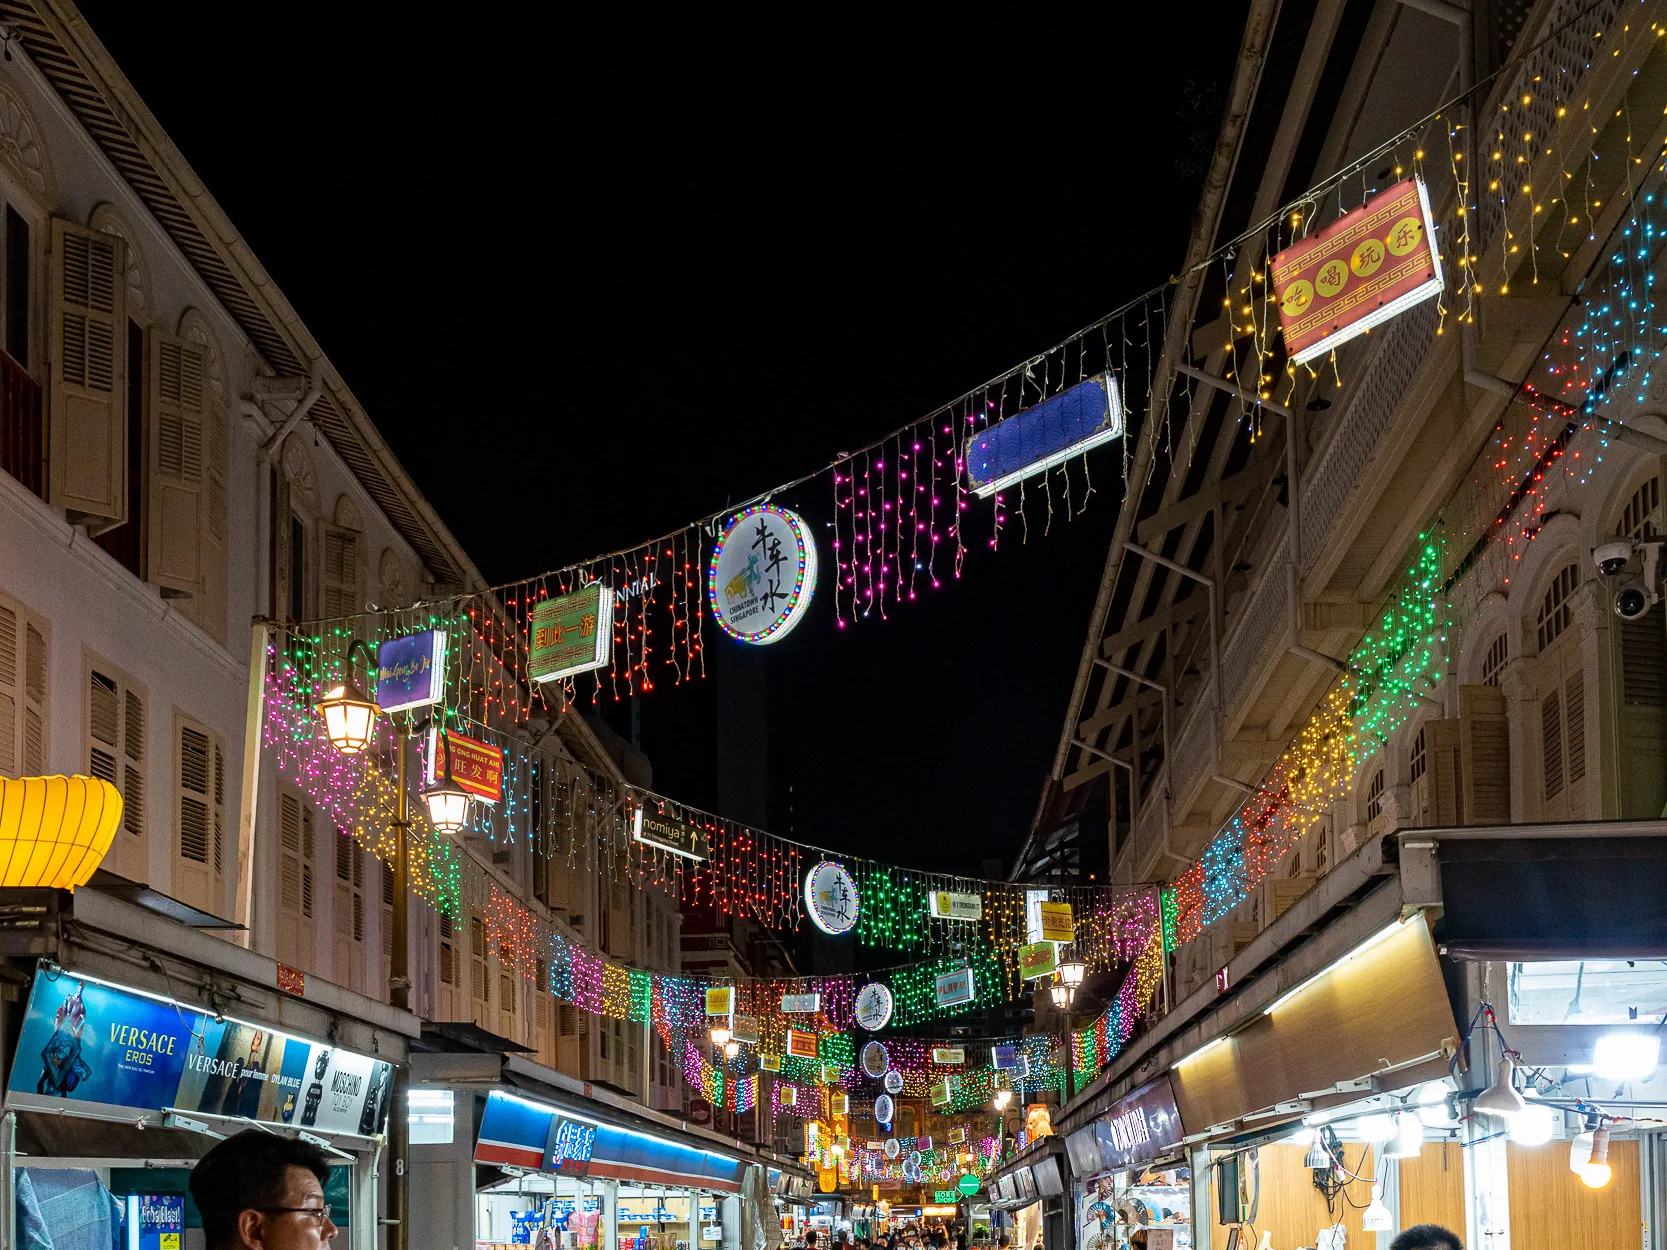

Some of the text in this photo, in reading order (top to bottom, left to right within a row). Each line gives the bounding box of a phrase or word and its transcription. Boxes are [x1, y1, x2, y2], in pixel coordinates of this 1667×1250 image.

[1286, 223, 1415, 306] 吃喝玩乐
[752, 518, 789, 614] 牛车水
[729, 596, 759, 615] CHINATOWN
[730, 606, 759, 624] SINGAPORE
[535, 613, 595, 651] 到此一游
[457, 748, 471, 758] ONG
[471, 753, 488, 764] HUAT
[643, 818, 680, 839] nomiya
[834, 872, 851, 924] 牛车水
[938, 982, 958, 995] PLAY
[110, 1022, 177, 1056] VERSACE
[125, 1049, 153, 1066] EROS
[188, 1053, 302, 1088] VERSACE pour femme DYLAN BLUE
[395, 1158, 404, 1175] 8
